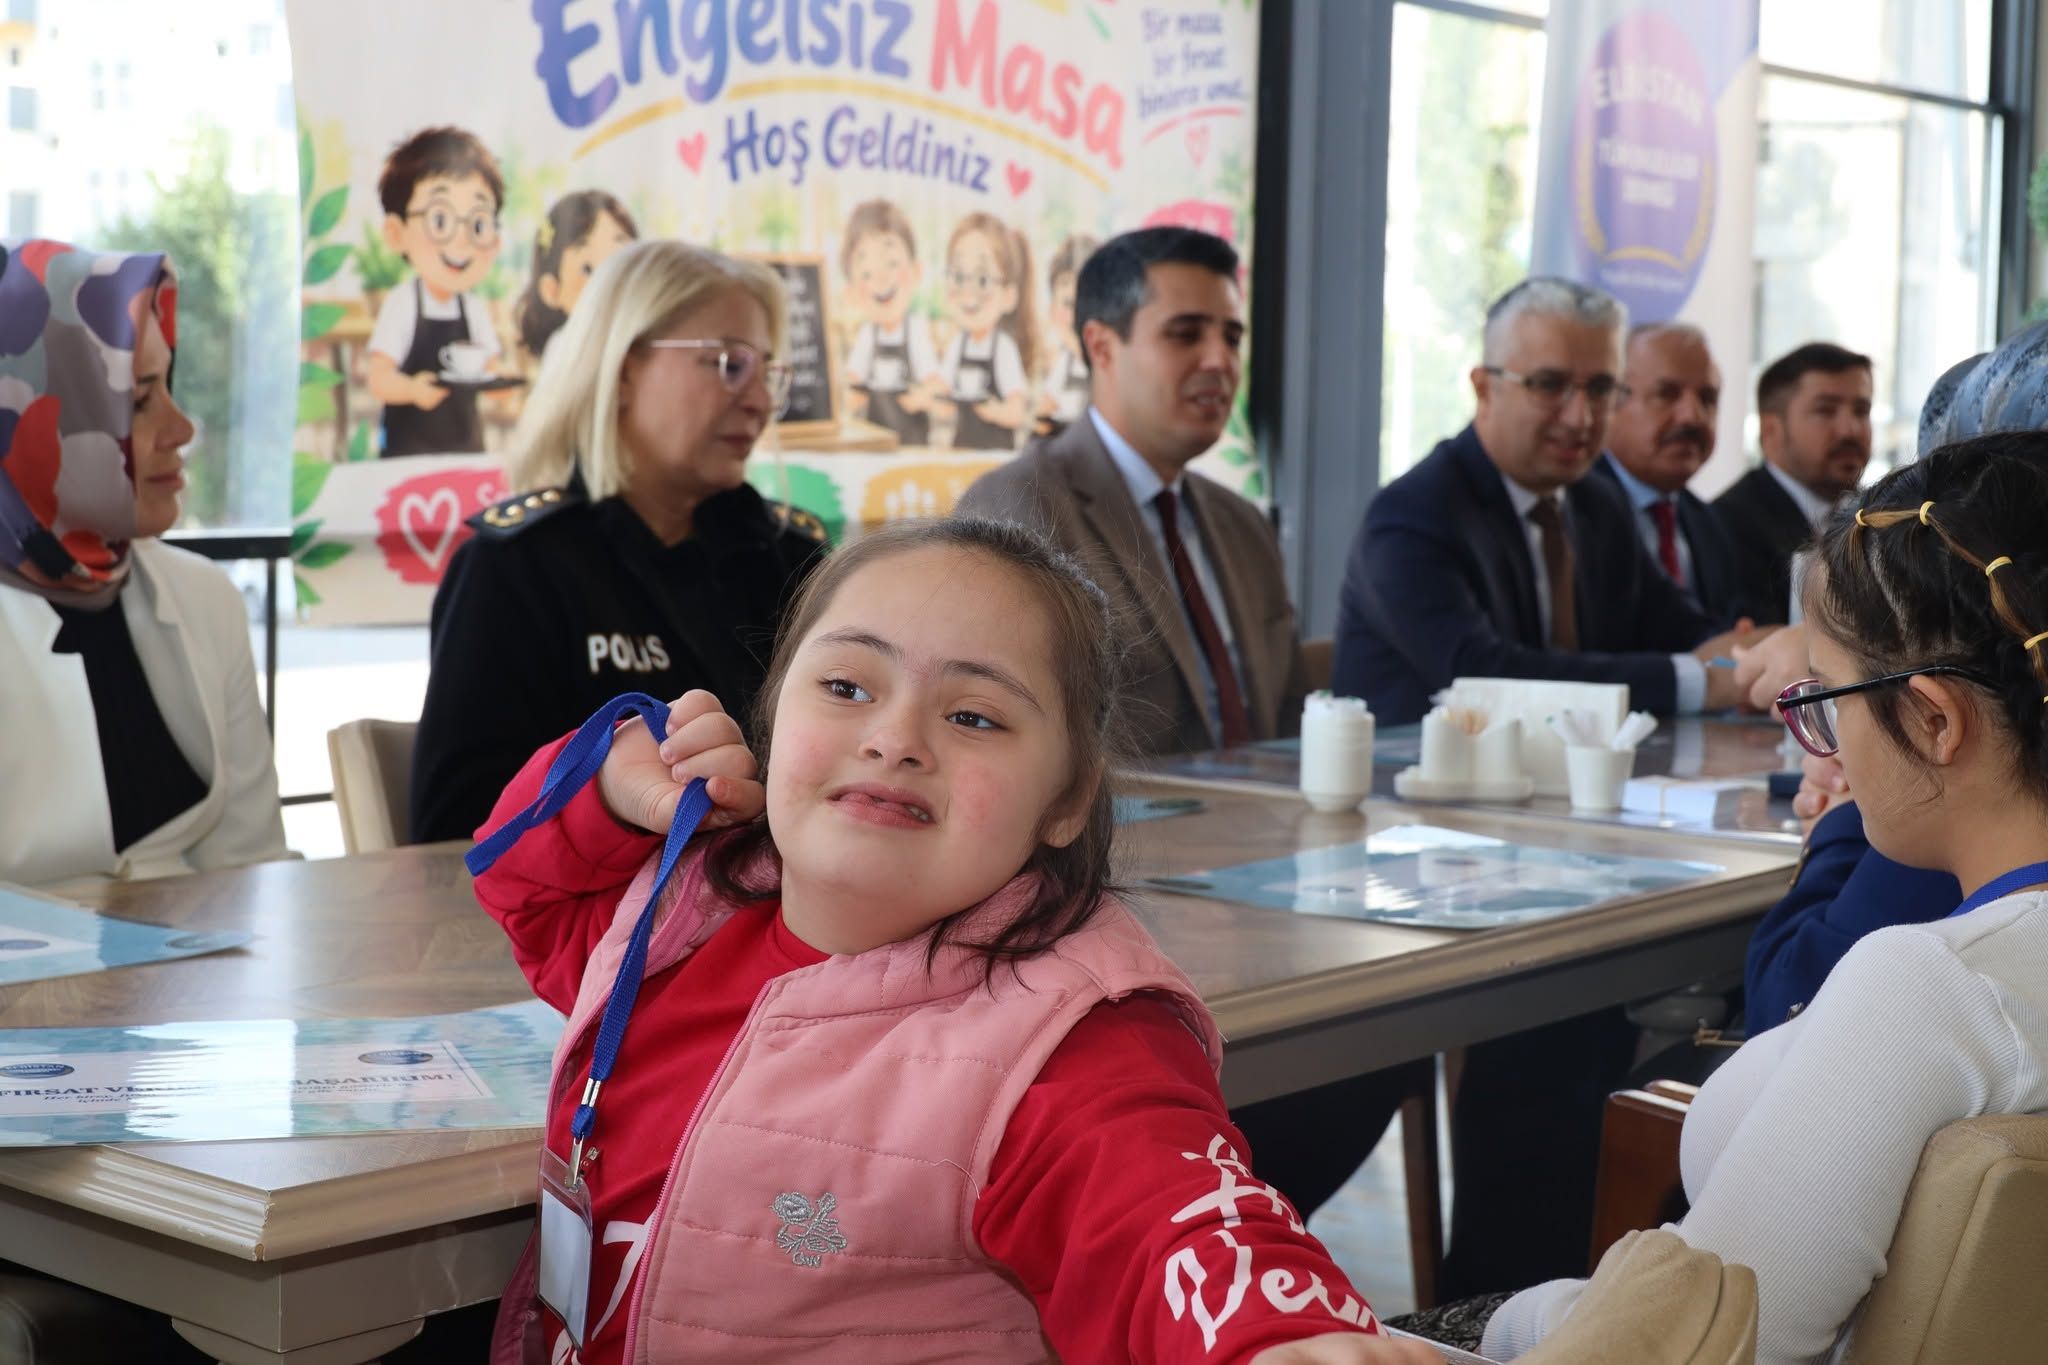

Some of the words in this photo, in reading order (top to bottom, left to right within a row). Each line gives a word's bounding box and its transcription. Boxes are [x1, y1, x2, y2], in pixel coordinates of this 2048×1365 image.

[531, 0, 914, 129] Engelsiz
[930, 0, 1125, 172] Masa
[721, 108, 810, 186] Hoş
[823, 105, 993, 194] Geldiniz
